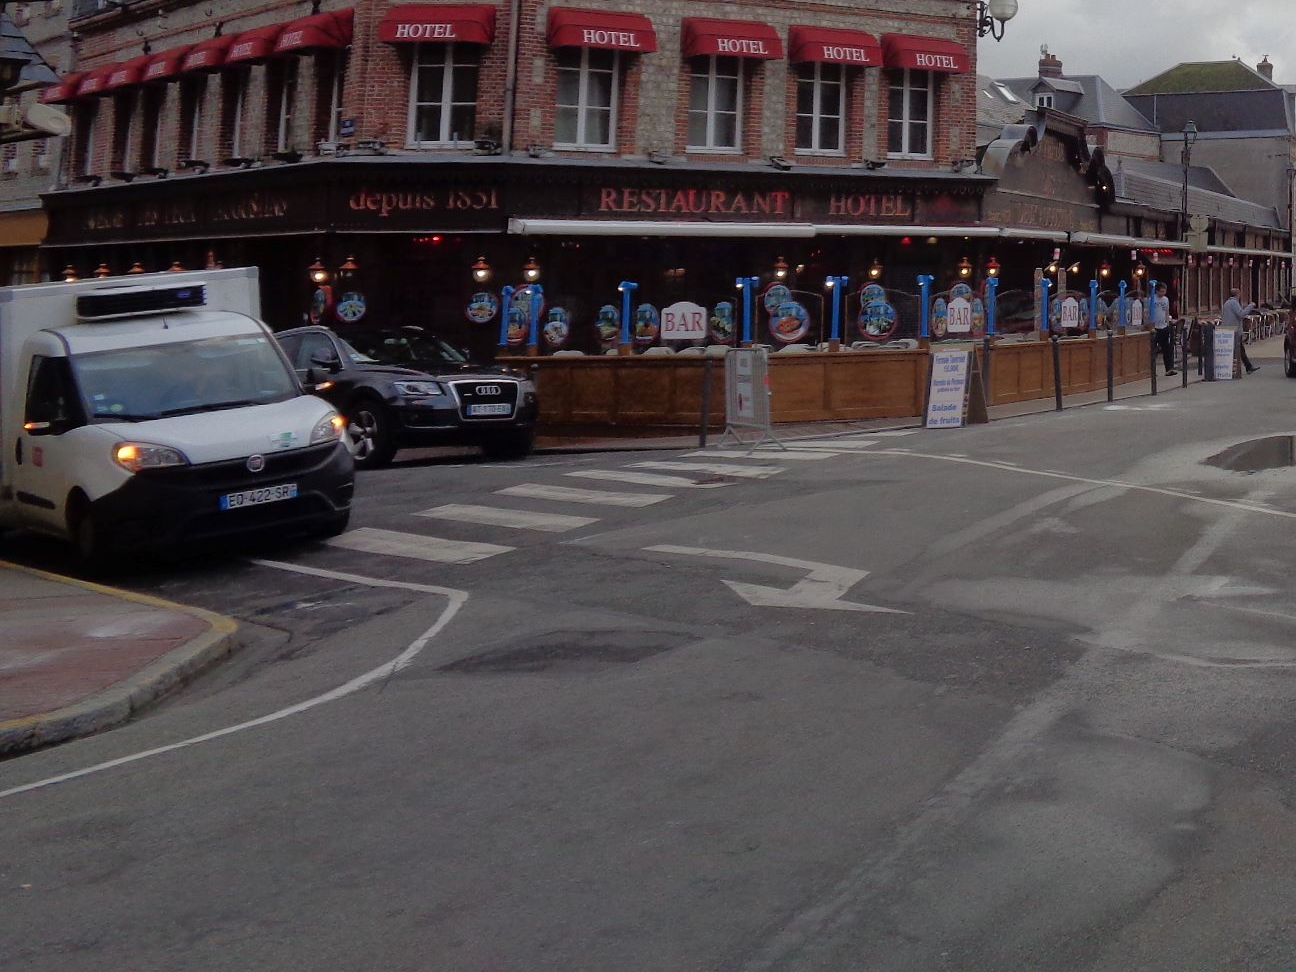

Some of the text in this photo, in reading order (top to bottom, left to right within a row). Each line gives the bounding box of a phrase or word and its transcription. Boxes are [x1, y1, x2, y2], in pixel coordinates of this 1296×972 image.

[396, 23, 456, 38] HOTEL
[583, 29, 640, 47] HOTEL
[717, 38, 768, 55] HOTEL
[823, 46, 869, 62] HOTEL
[916, 53, 959, 69] HOTEL
[349, 187, 435, 217] depuis
[599, 187, 912, 217] RESTAURANT HOTEL
[664, 312, 703, 332] BAR
[949, 307, 970, 326] BAR
[1062, 305, 1079, 322] BAR
[931, 403, 957, 412] Salade
[940, 416, 960, 424] fruits
